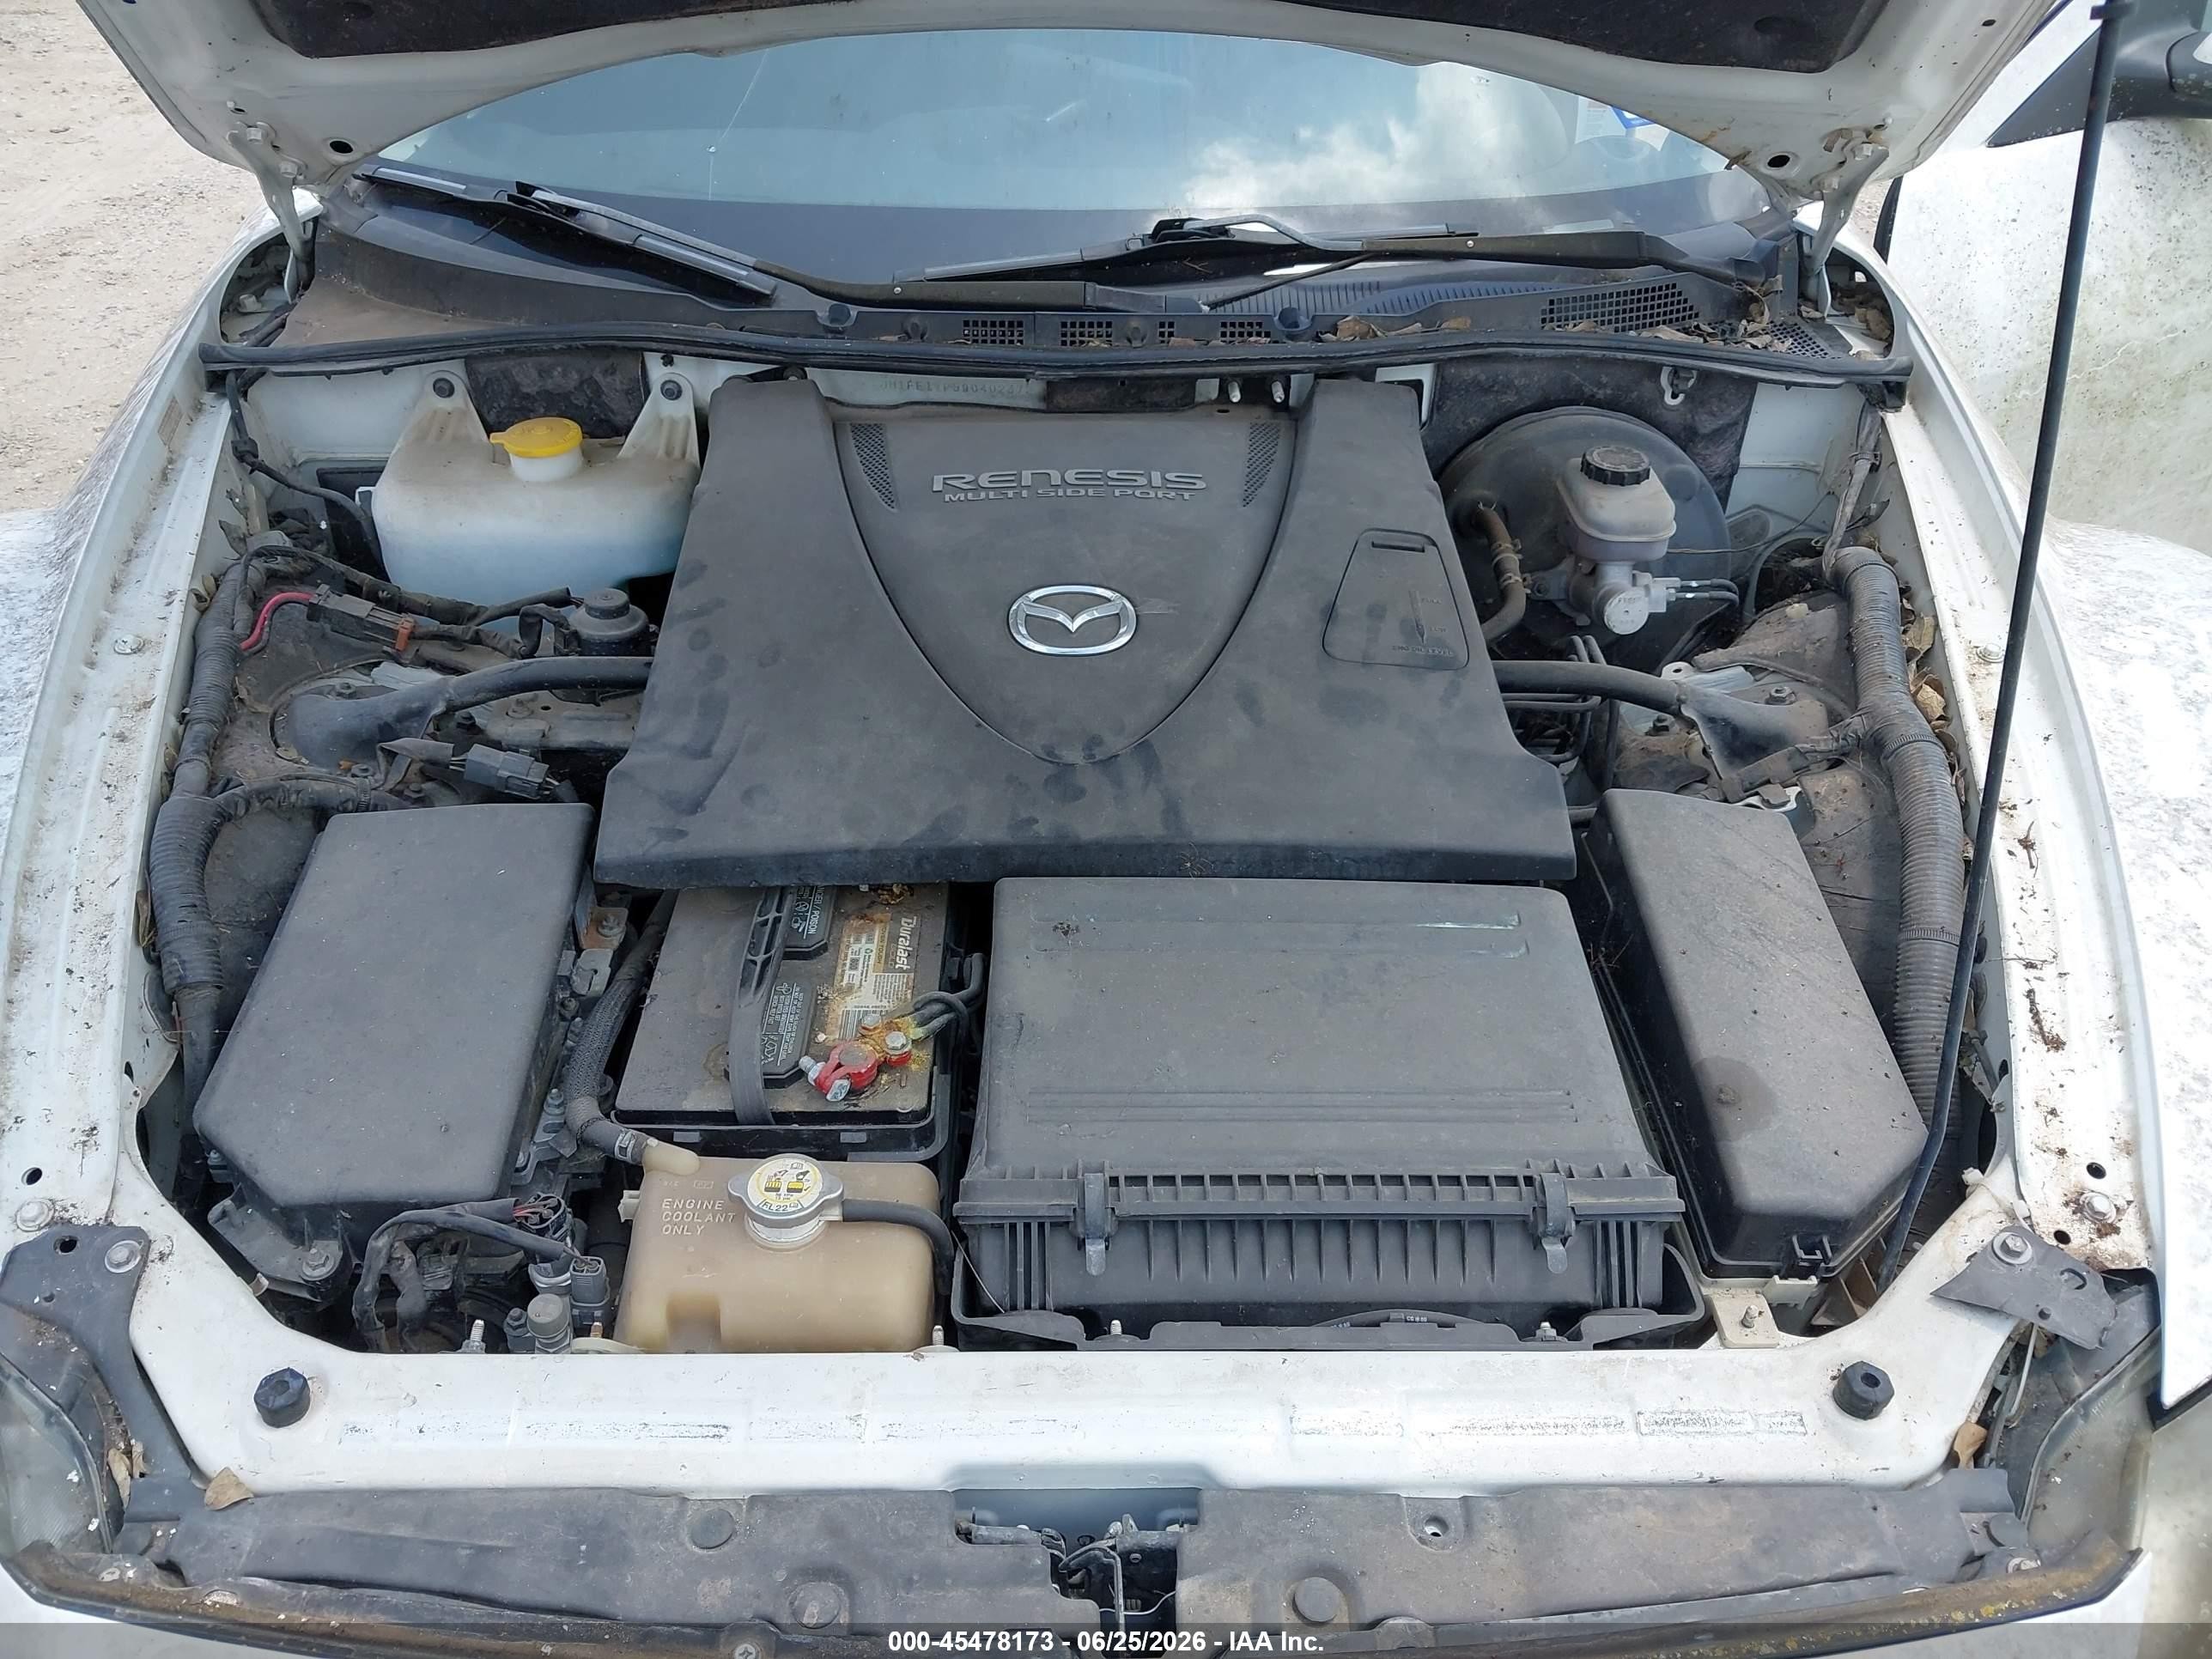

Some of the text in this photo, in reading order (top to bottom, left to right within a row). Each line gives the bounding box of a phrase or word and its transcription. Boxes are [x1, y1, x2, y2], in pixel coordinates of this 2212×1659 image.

[933, 469, 1206, 492] RENESIS
[945, 489, 1196, 502] MULTI SIDE PORT
[807, 910, 820, 934] POISON
[895, 916, 917, 970] Duralast
[662, 1199, 724, 1210] ENGINE
[762, 1201, 788, 1212] FL22
[662, 1211, 735, 1224] COOLANT
[662, 1224, 705, 1235] ONLY
